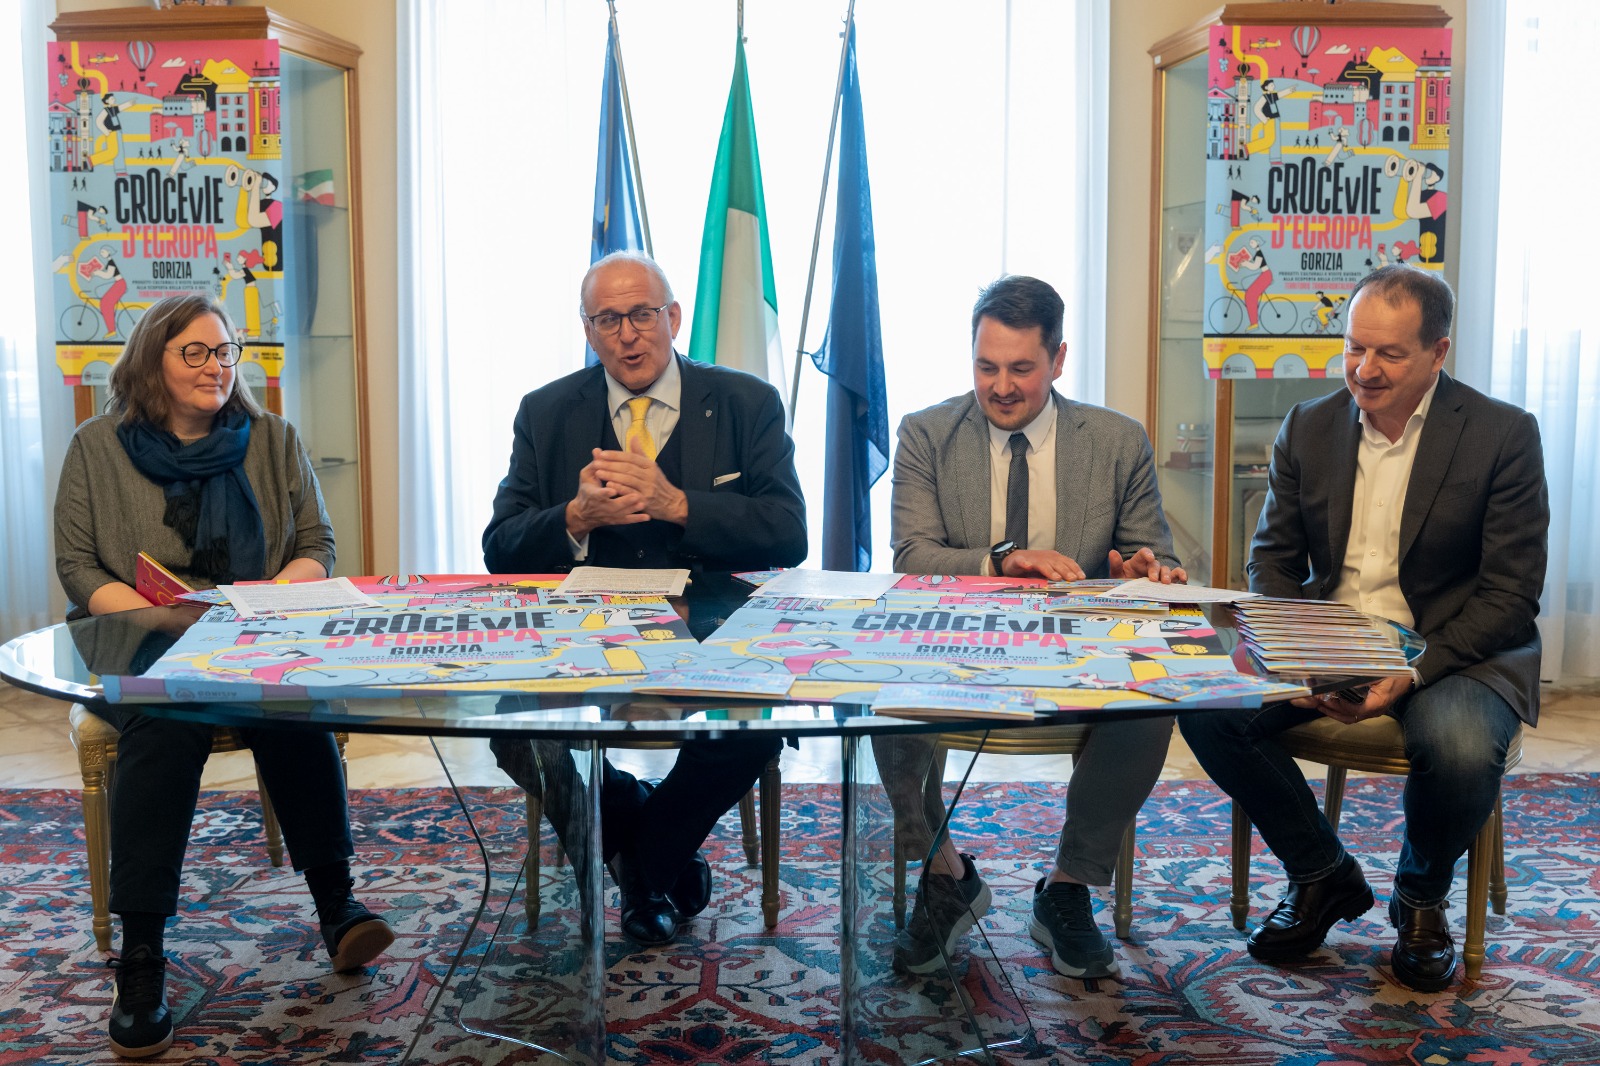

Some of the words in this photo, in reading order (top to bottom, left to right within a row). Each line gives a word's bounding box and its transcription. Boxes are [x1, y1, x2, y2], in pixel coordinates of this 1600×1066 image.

[122, 225, 218, 258] D'EUROPA
[1271, 215, 1372, 250] D'EUROPA
[152, 261, 192, 279] GORIZIA
[1301, 252, 1343, 271] GORIZIA
[323, 628, 543, 649] D'EUROPA
[853, 629, 1068, 648] D'EUROPA
[389, 644, 483, 655] GORIZIA
[916, 644, 1006, 655] GORIZIA
